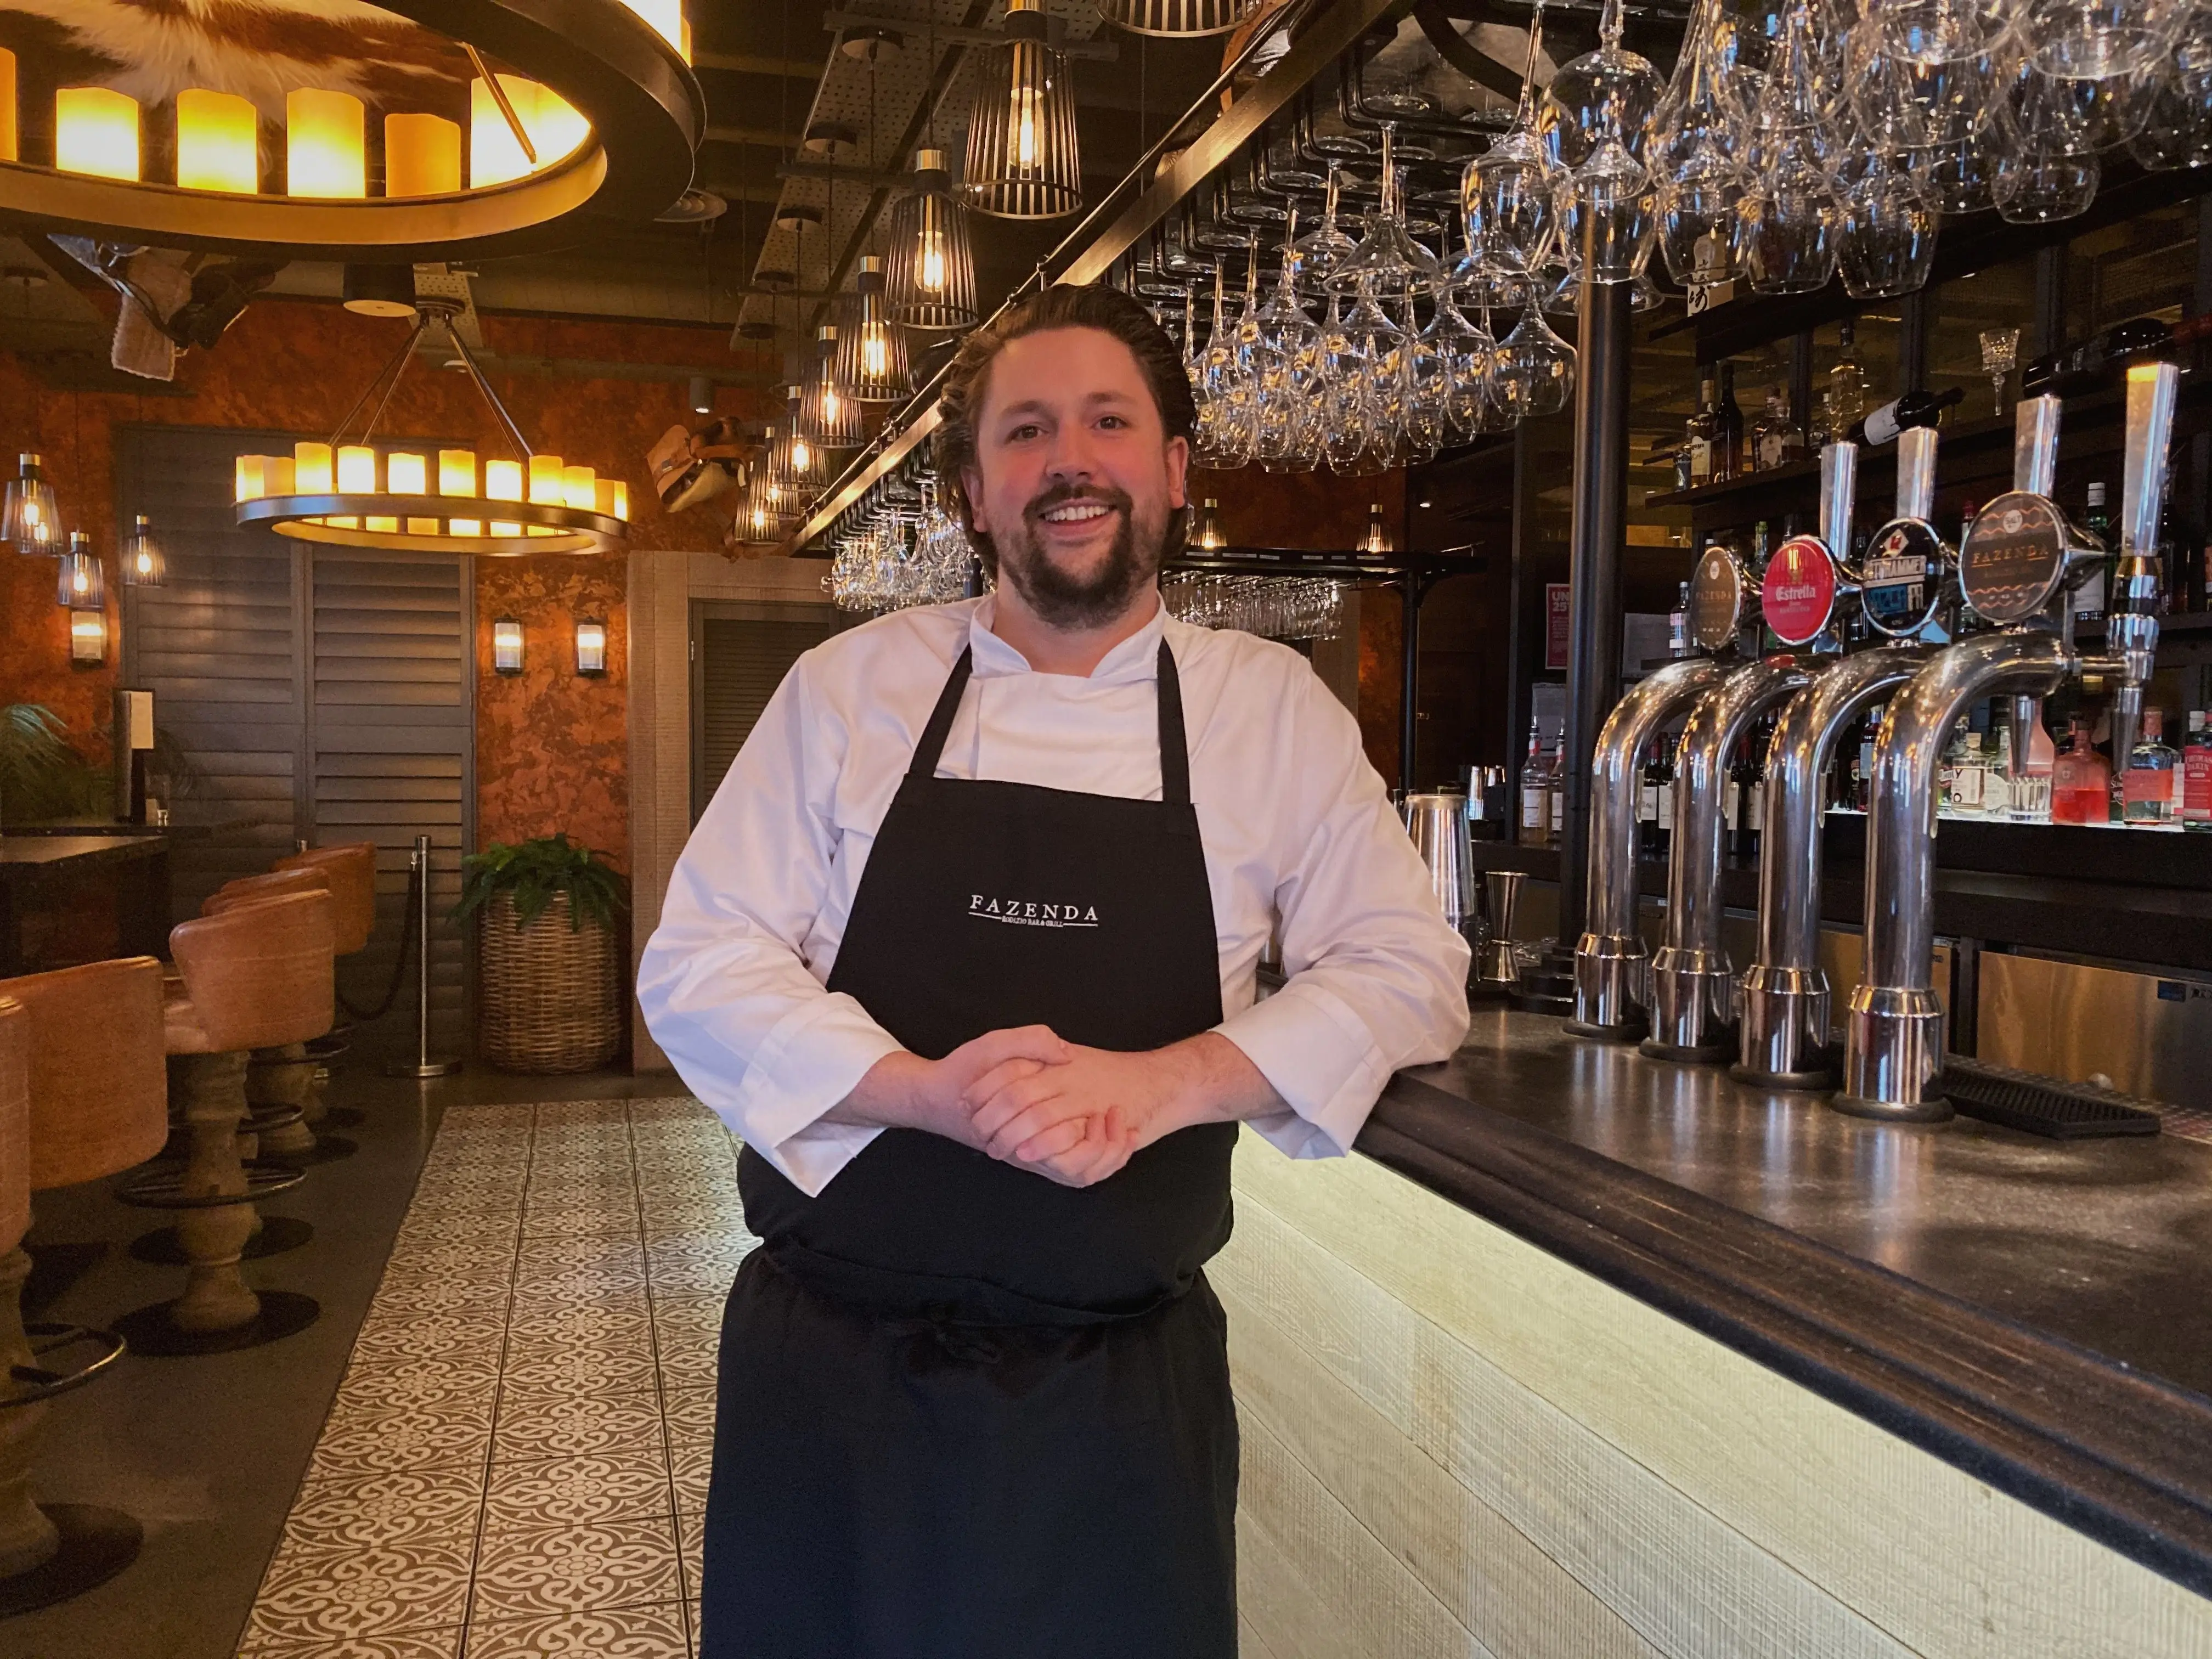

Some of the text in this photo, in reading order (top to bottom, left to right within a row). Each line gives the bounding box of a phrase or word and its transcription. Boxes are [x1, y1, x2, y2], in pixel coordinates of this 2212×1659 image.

[1972, 543, 2048, 563] FAZENDA
[1775, 585, 1815, 602] Estrella
[969, 895, 1098, 921] FAZENDA
[1001, 915, 1027, 924] RODIZIO
